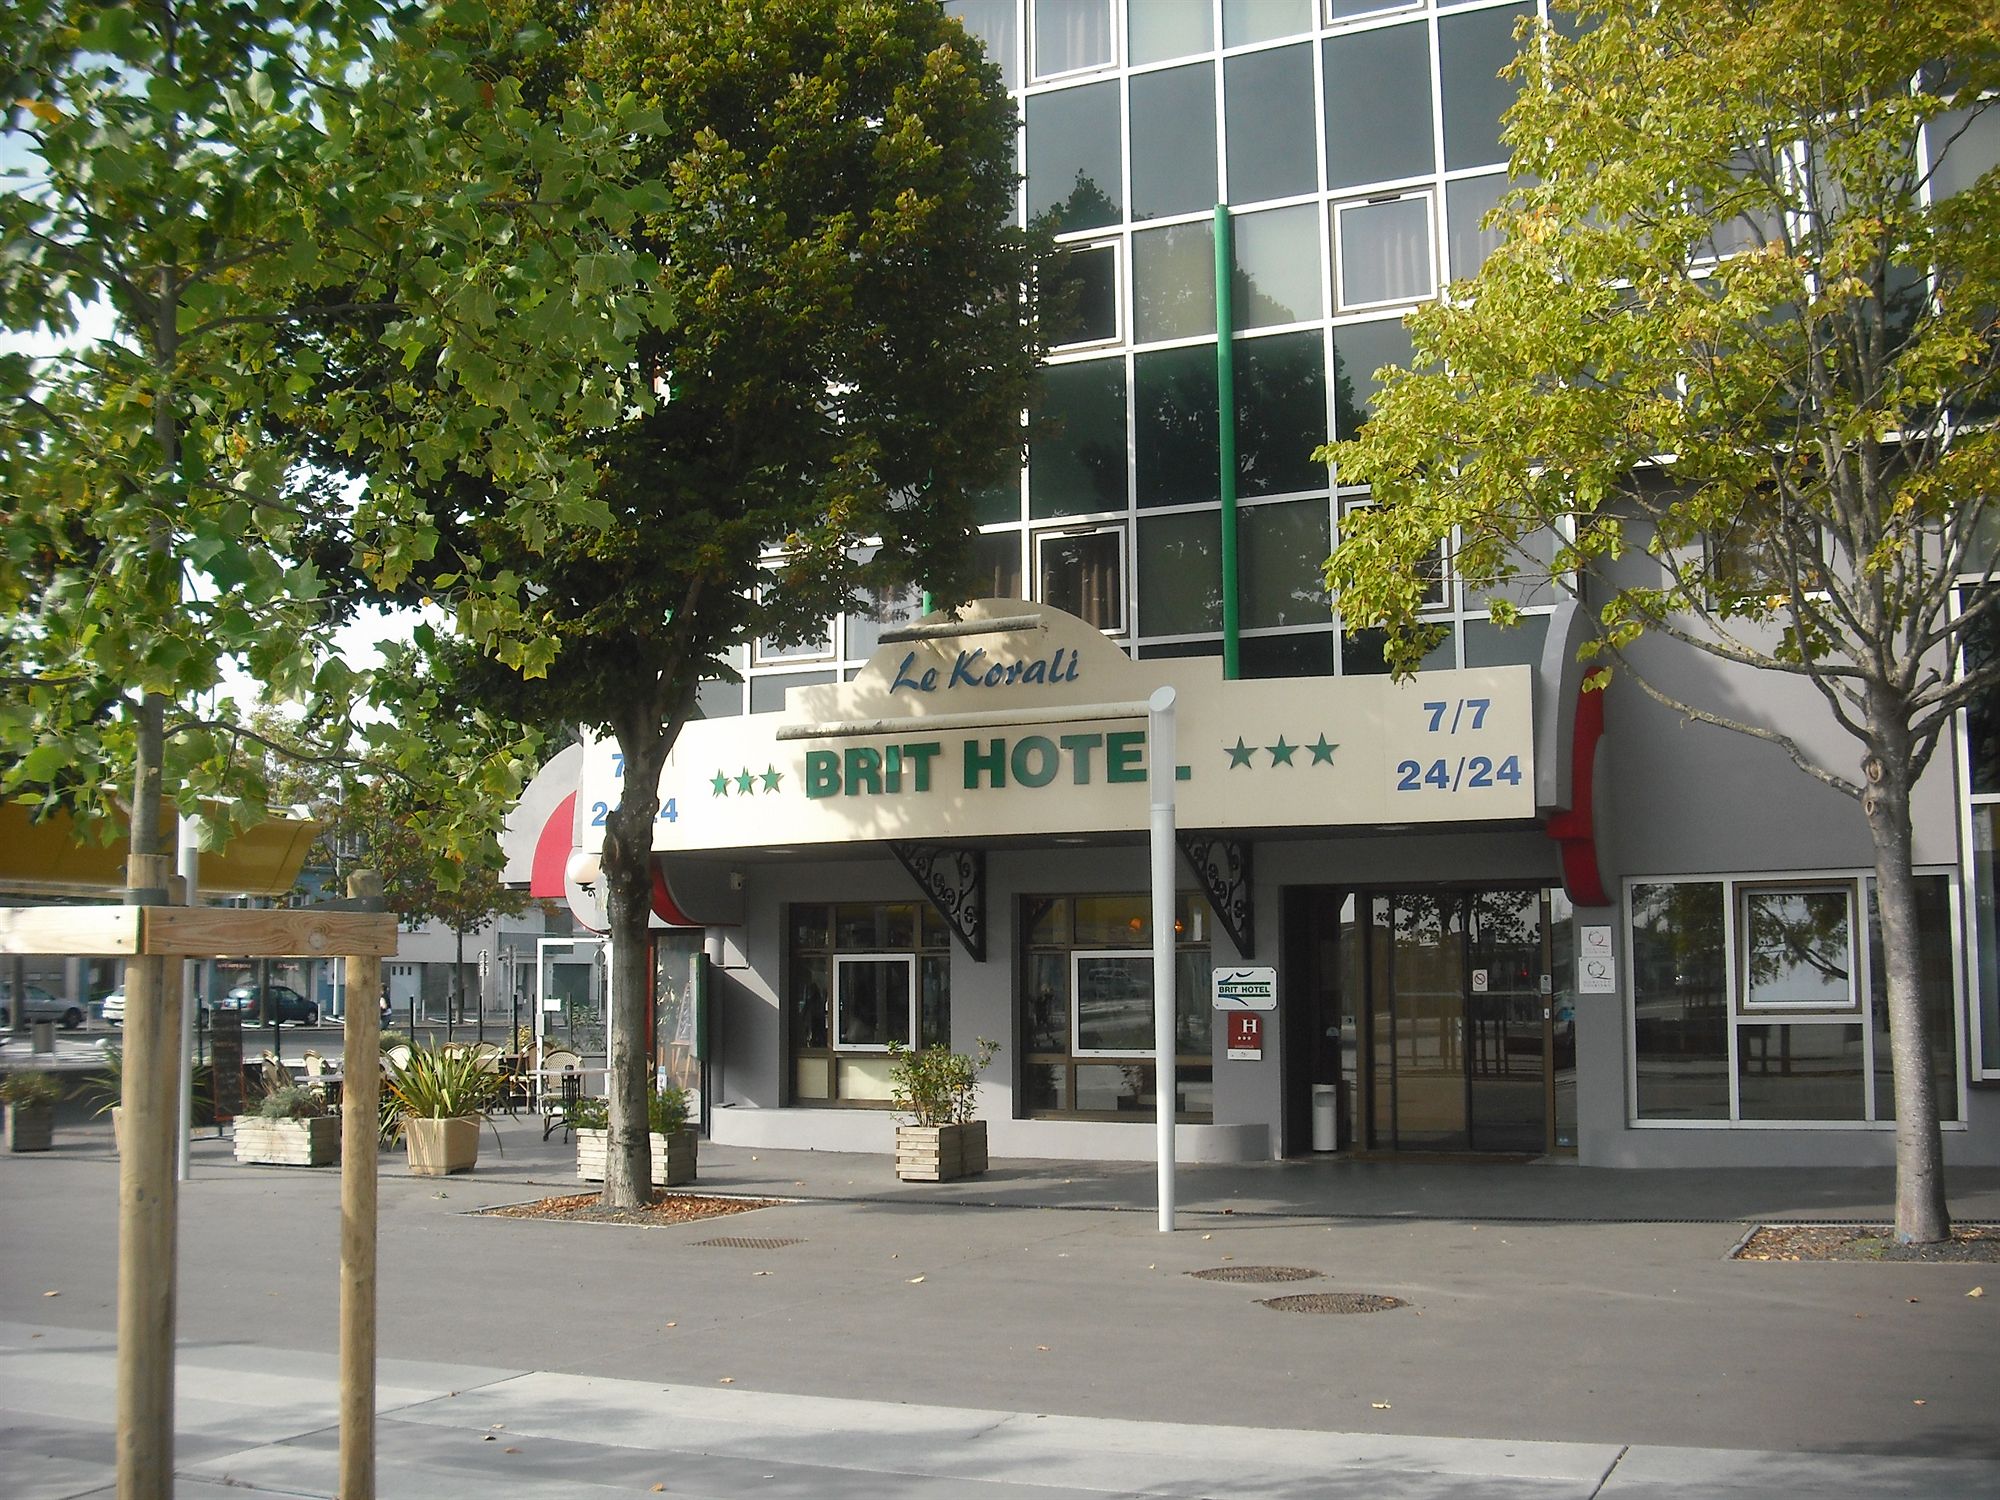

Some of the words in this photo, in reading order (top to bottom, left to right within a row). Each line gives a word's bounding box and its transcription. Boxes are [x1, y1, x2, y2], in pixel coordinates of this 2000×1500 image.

[889, 651, 937, 694] Le
[948, 647, 1079, 689] Korali
[1423, 698, 1490, 734] 7/7
[805, 742, 941, 799] BRIT
[963, 731, 1191, 789] HOTE
[1397, 755, 1522, 792] 24/24
[1242, 1019, 1257, 1033] H
